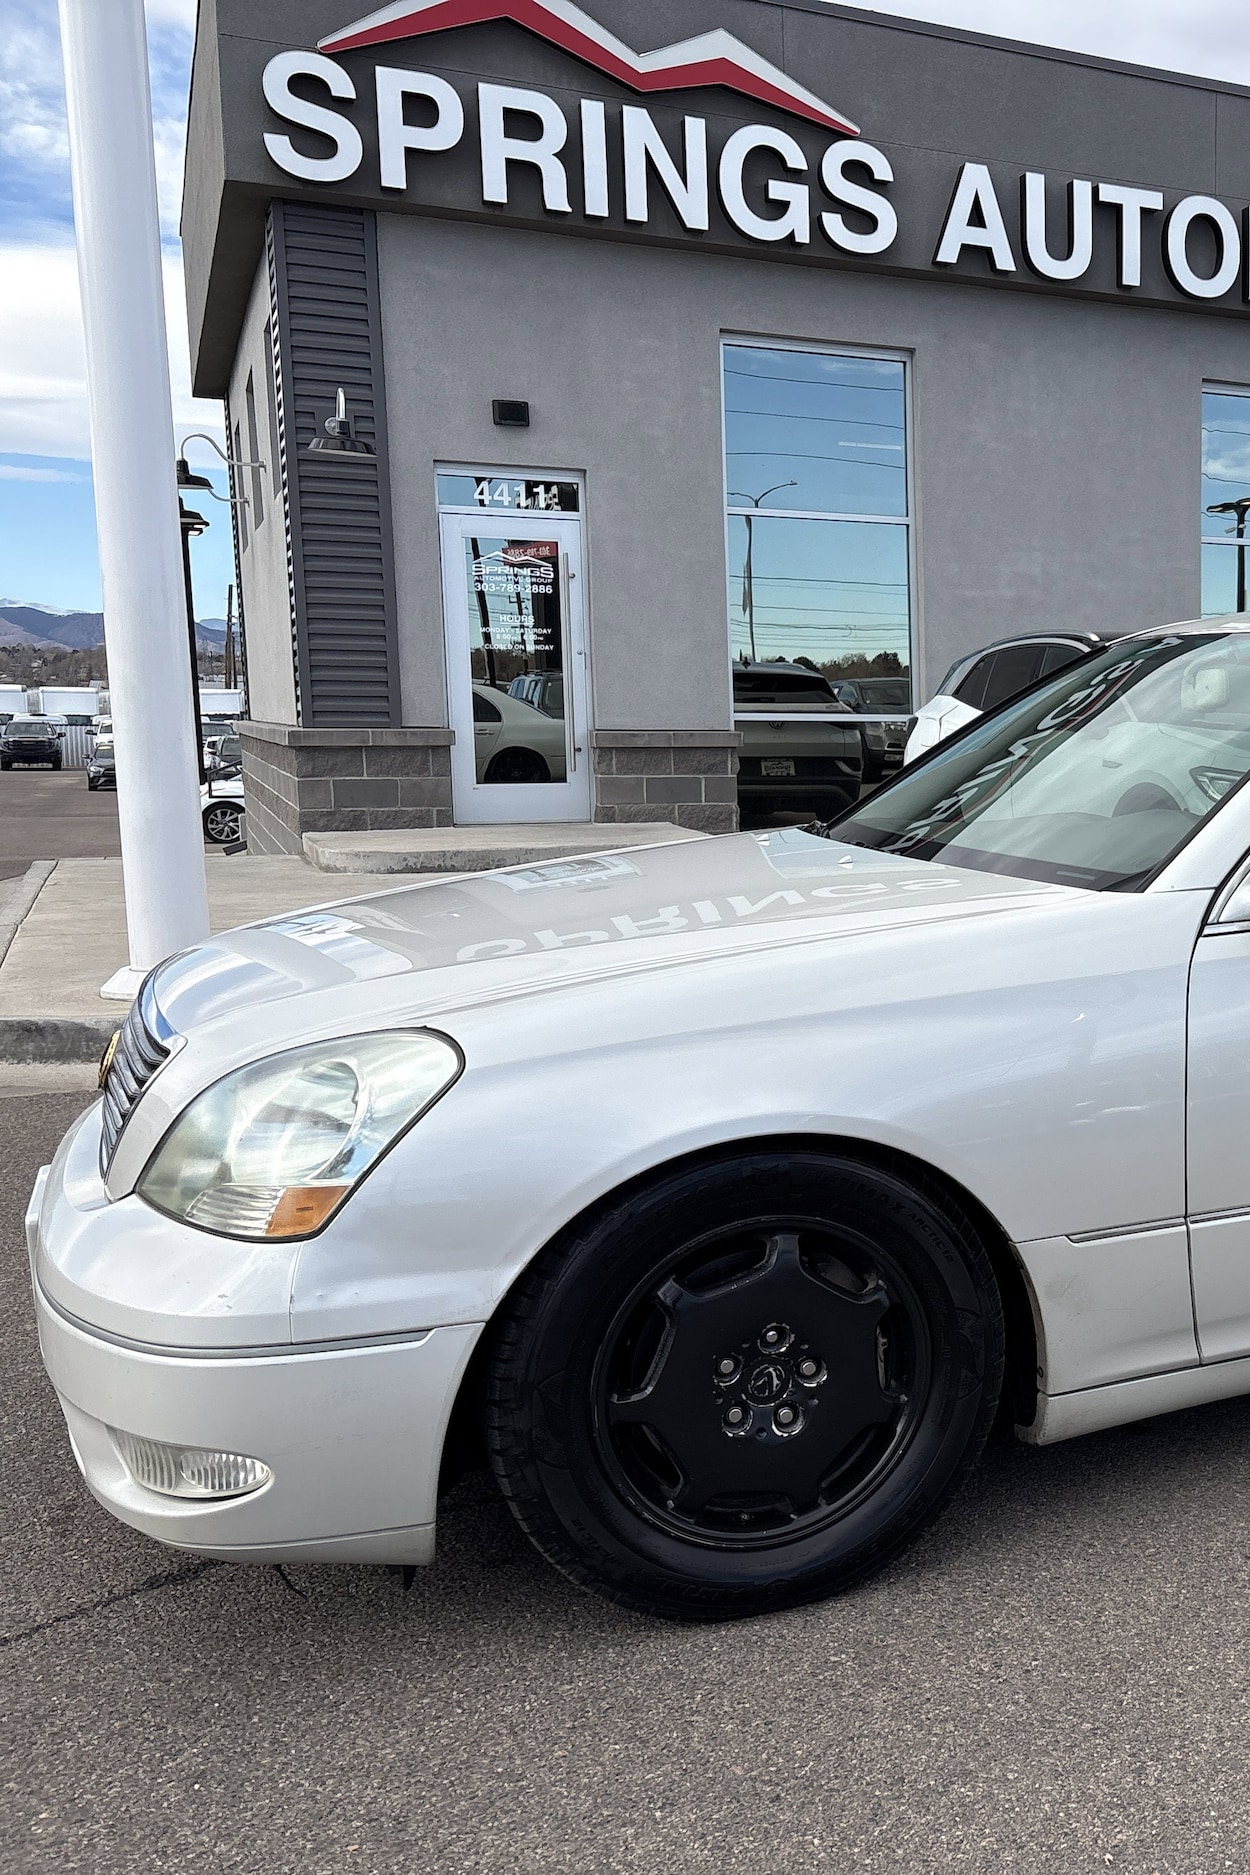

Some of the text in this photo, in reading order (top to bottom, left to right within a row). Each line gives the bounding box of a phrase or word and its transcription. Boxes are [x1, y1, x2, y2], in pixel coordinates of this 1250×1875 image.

[262, 51, 898, 254] SPRINGS
[474, 481, 545, 507] 4411
[472, 564, 554, 578] SPRINGS
[474, 582, 553, 594] 303-789-2886
[500, 615, 535, 623] HOURS
